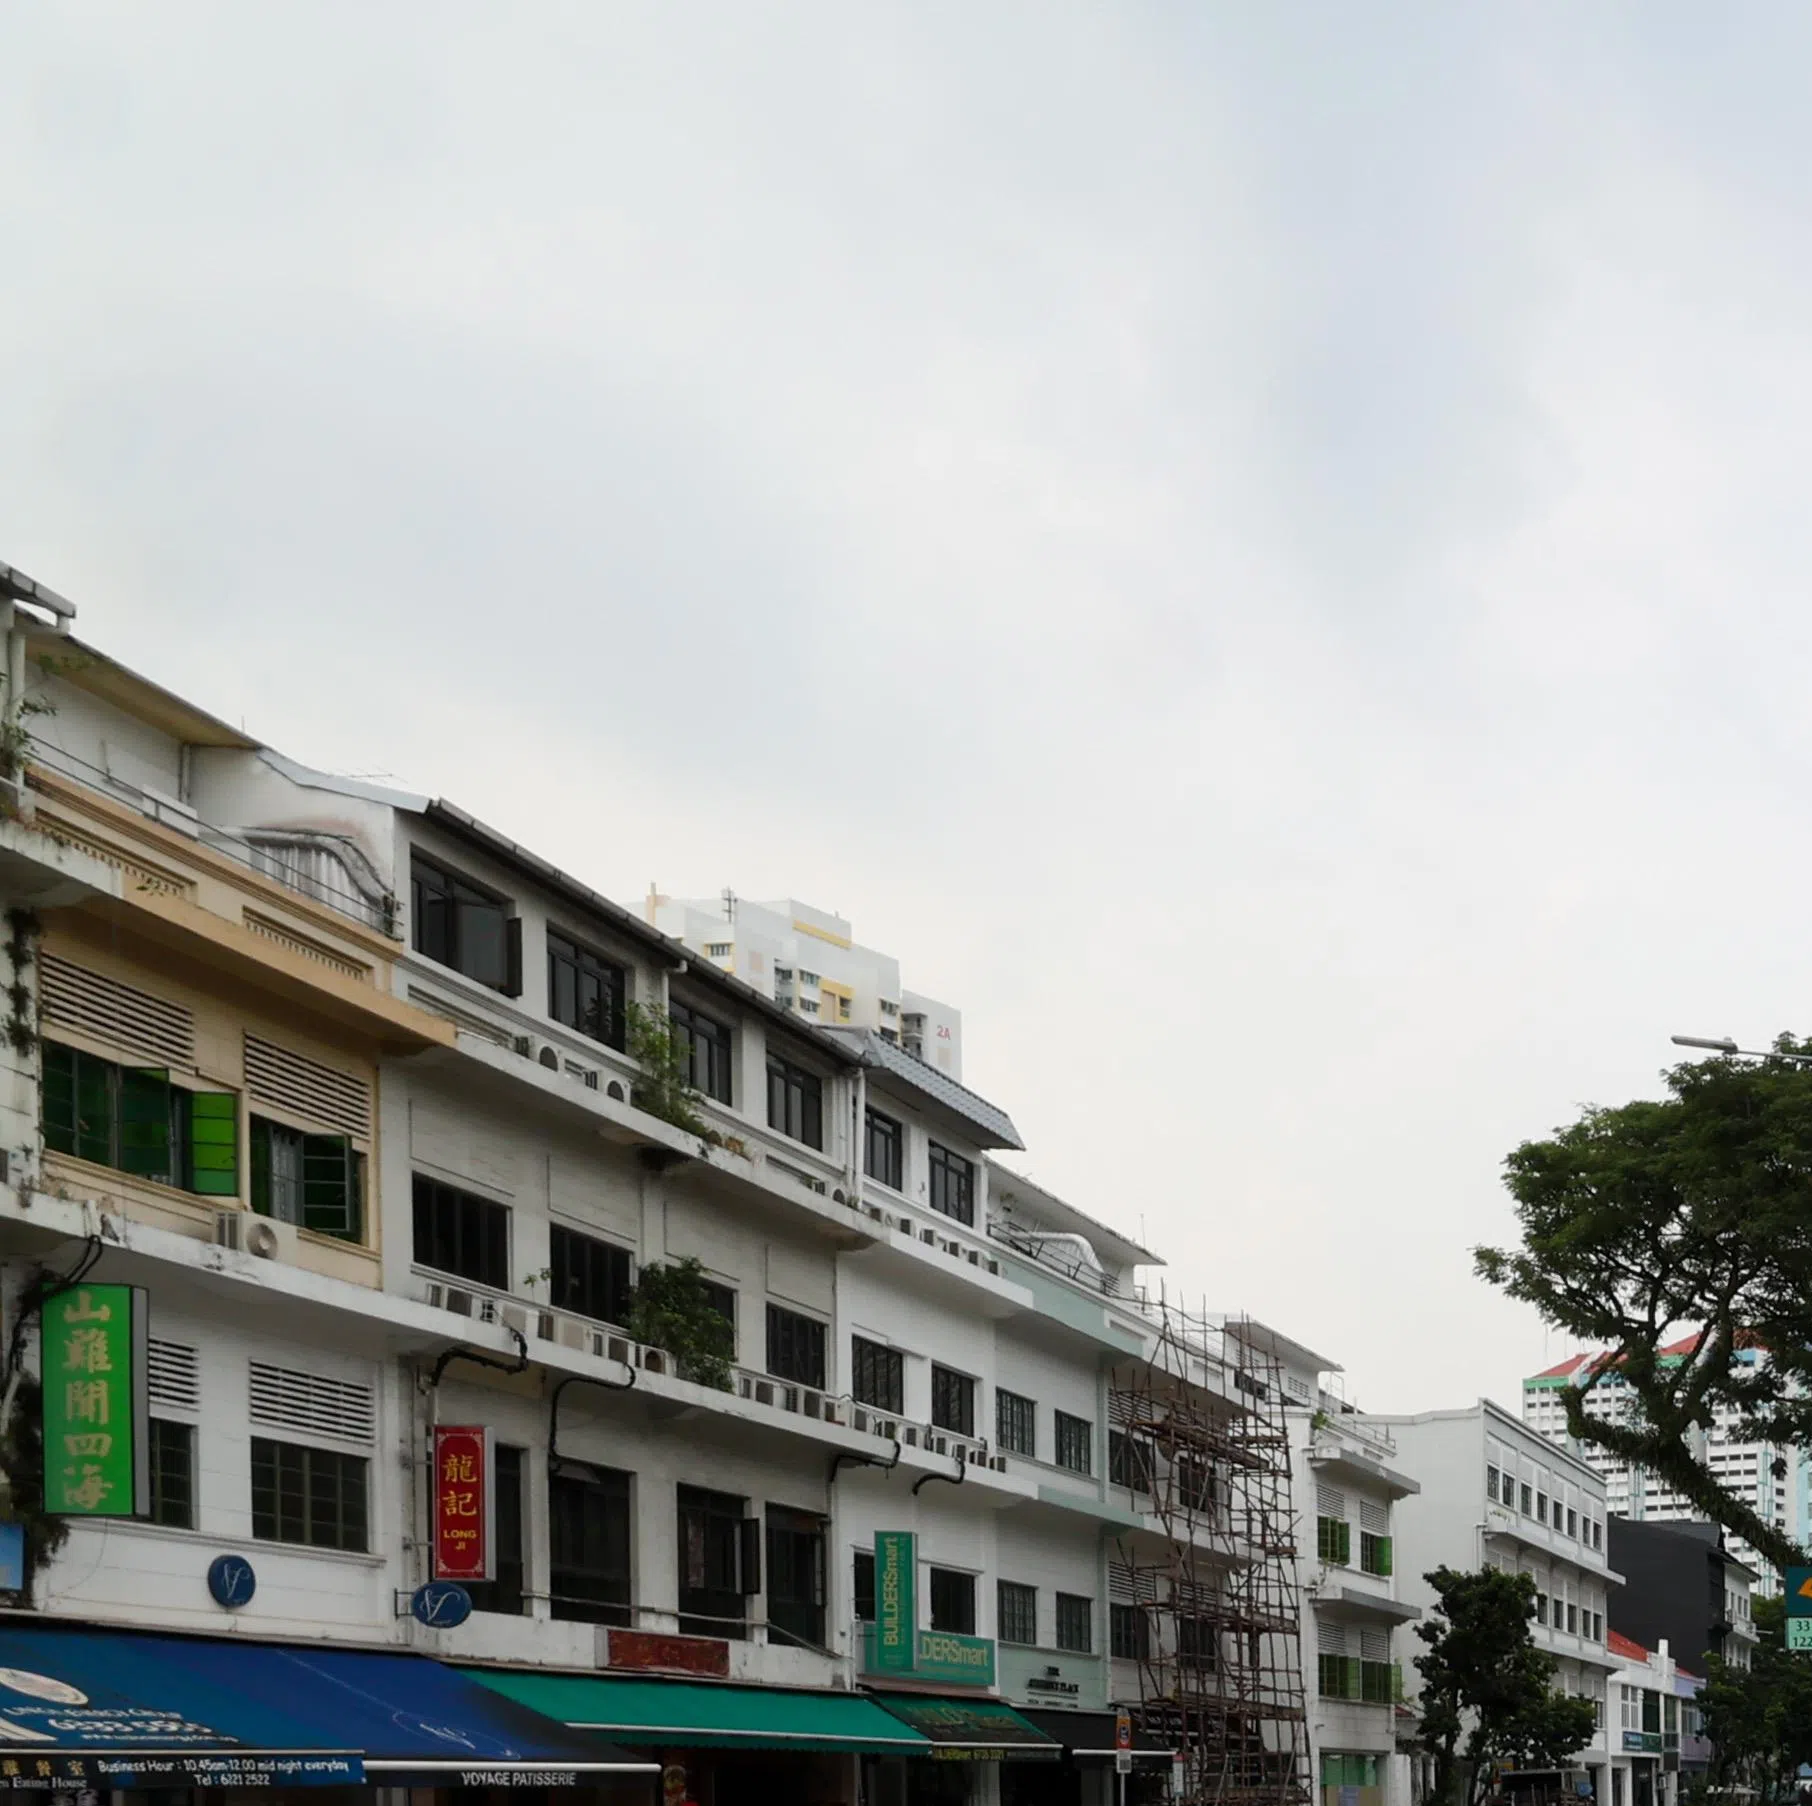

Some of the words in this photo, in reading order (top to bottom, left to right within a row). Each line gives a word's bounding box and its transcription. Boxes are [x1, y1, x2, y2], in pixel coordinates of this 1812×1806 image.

[443, 1455, 477, 1517] 龍記
[444, 1530, 476, 1539] LONG
[455, 1542, 466, 1550] JI
[883, 1536, 899, 1646] BUILDERSmart
[1796, 1621, 1810, 1632] 33
[919, 1635, 988, 1666] DERSmart
[97, 1760, 146, 1773] Business
[147, 1760, 174, 1772] Hour
[257, 1760, 275, 1772] mid
[277, 1760, 302, 1774] night
[305, 1760, 349, 1772] everyday
[52, 1776, 87, 1788] House
[194, 1774, 211, 1785] Tel
[245, 1774, 270, 1785] 2522
[461, 1772, 510, 1786] VOYAGE
[513, 1772, 576, 1786] PATISSERIE
